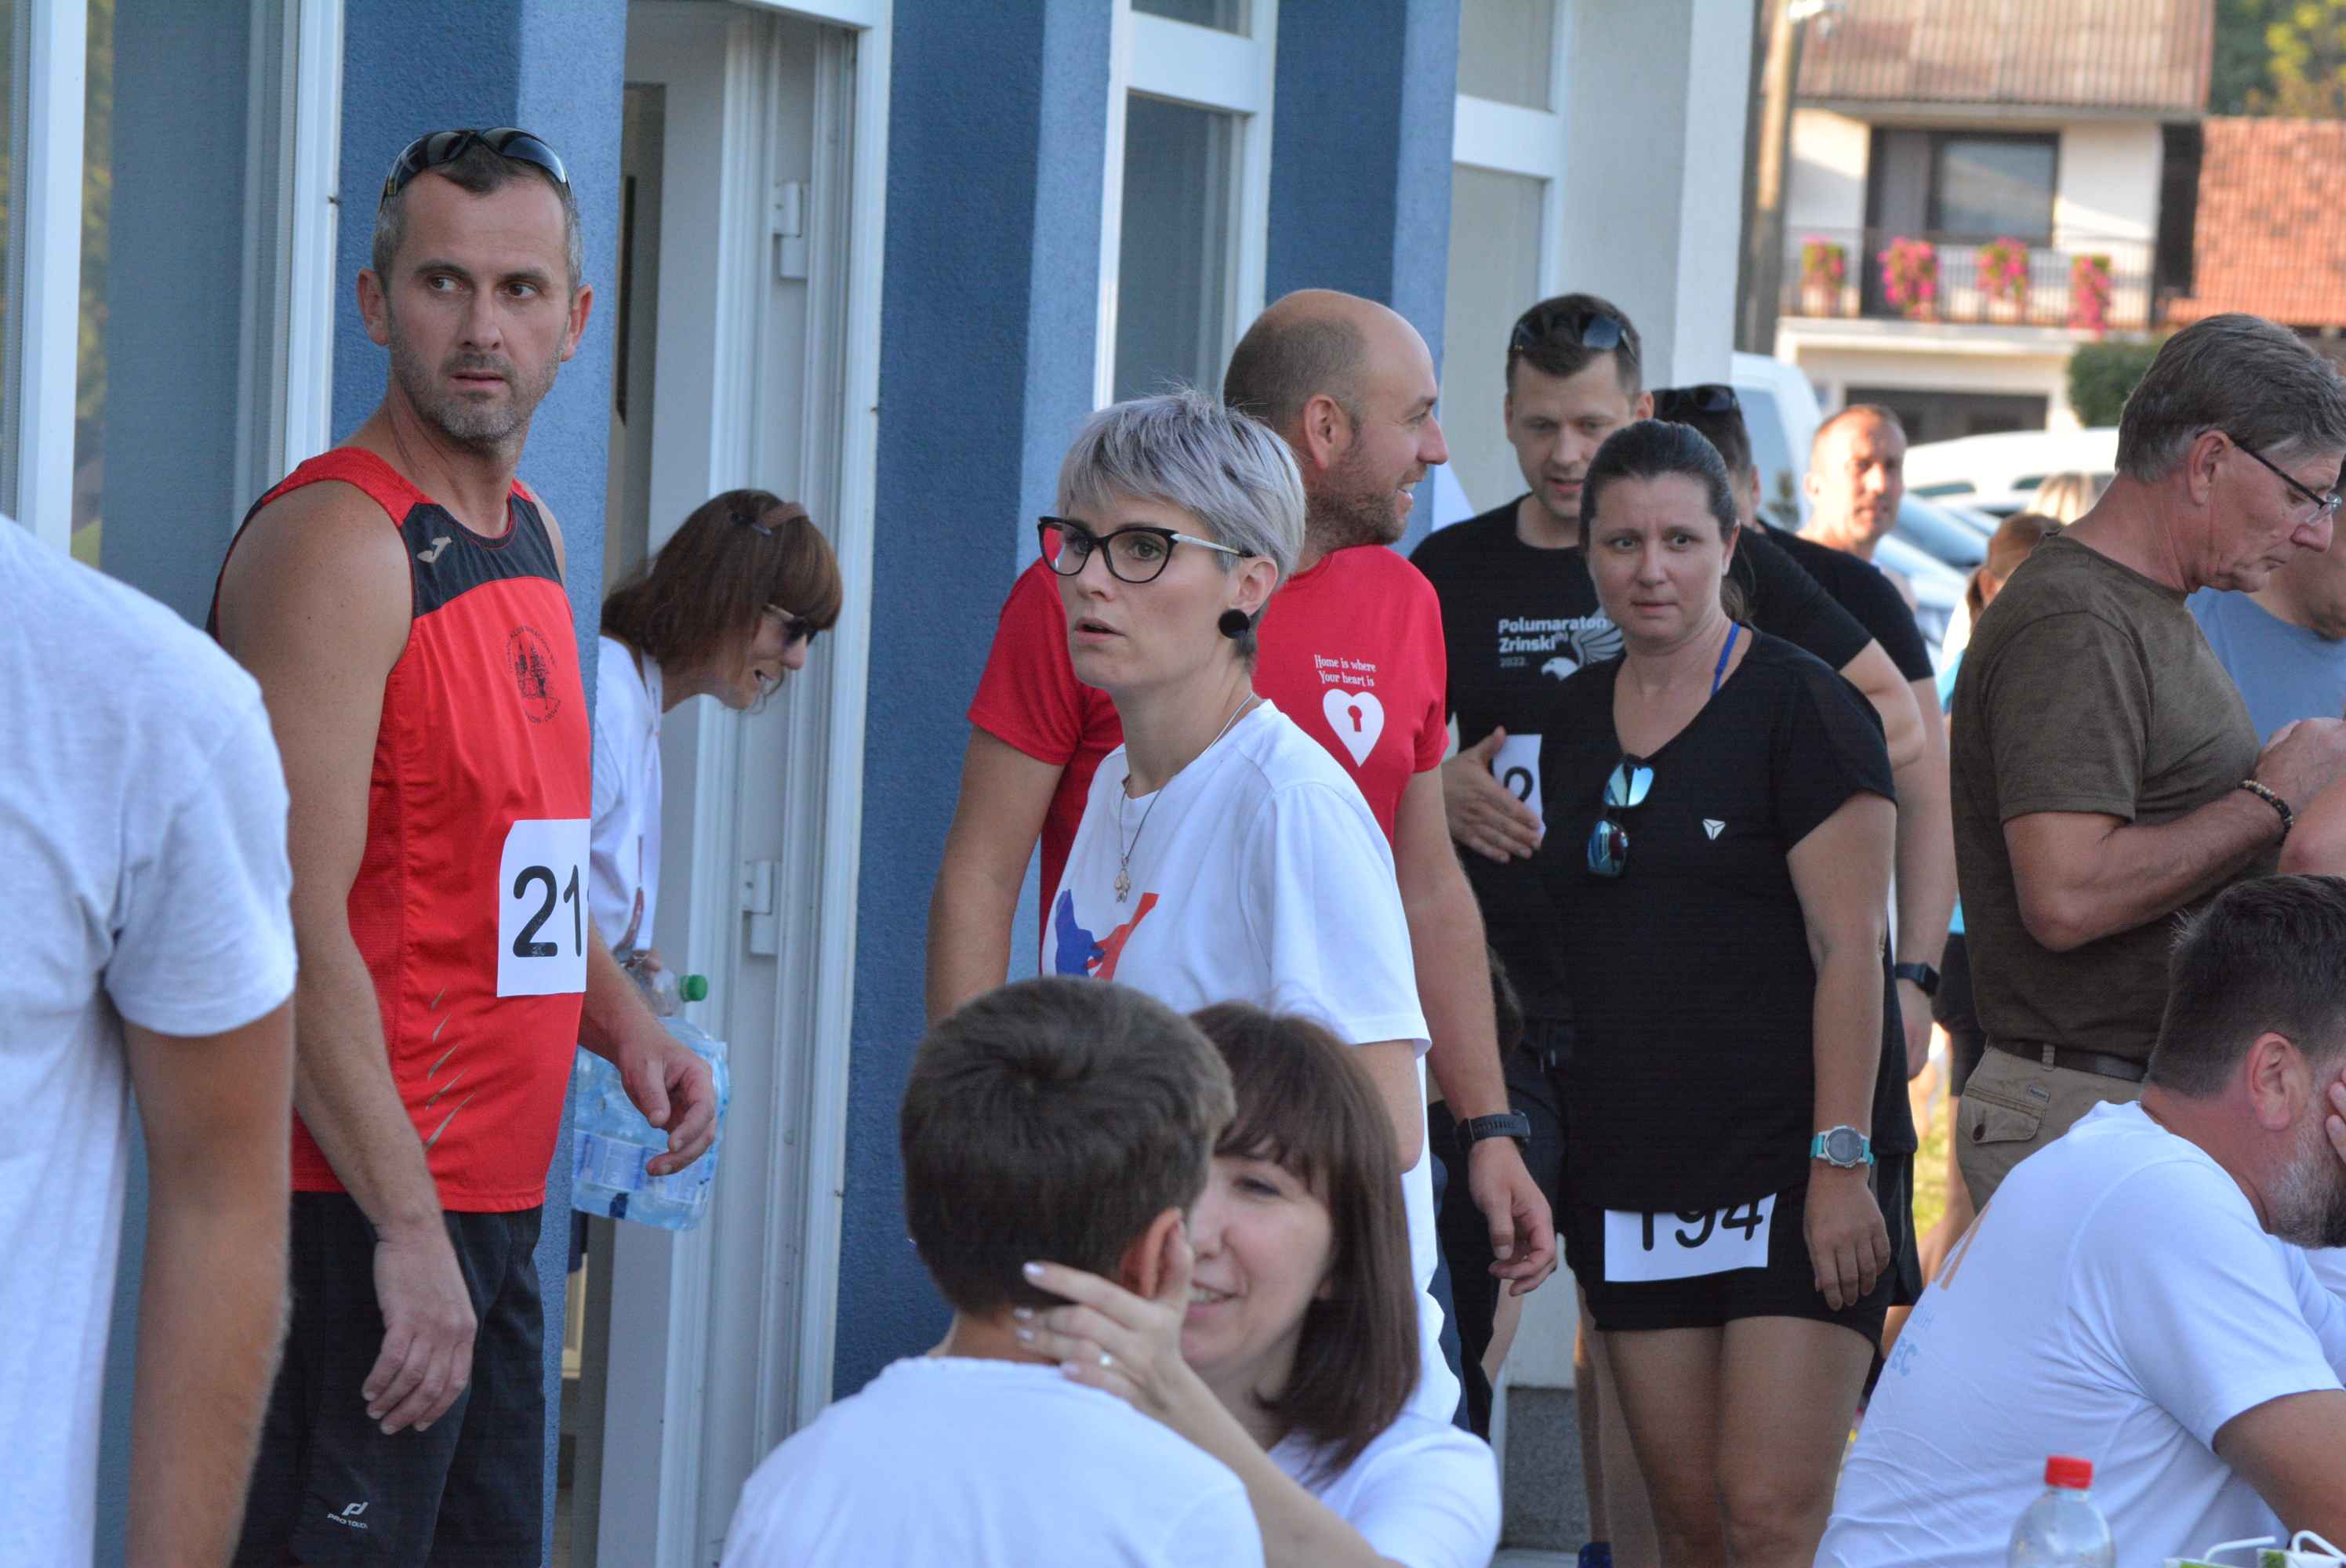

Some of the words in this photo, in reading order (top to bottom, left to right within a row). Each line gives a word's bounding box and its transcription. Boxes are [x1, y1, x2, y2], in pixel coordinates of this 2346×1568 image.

[1498, 615, 1607, 633] Polumaraton
[1314, 654, 1339, 669] Home
[1340, 657, 1349, 669] is
[1350, 659, 1377, 672] where
[1318, 670, 1340, 684] Your
[1342, 672, 1366, 687] heart
[1366, 675, 1375, 687] is
[512, 864, 589, 958] 21
